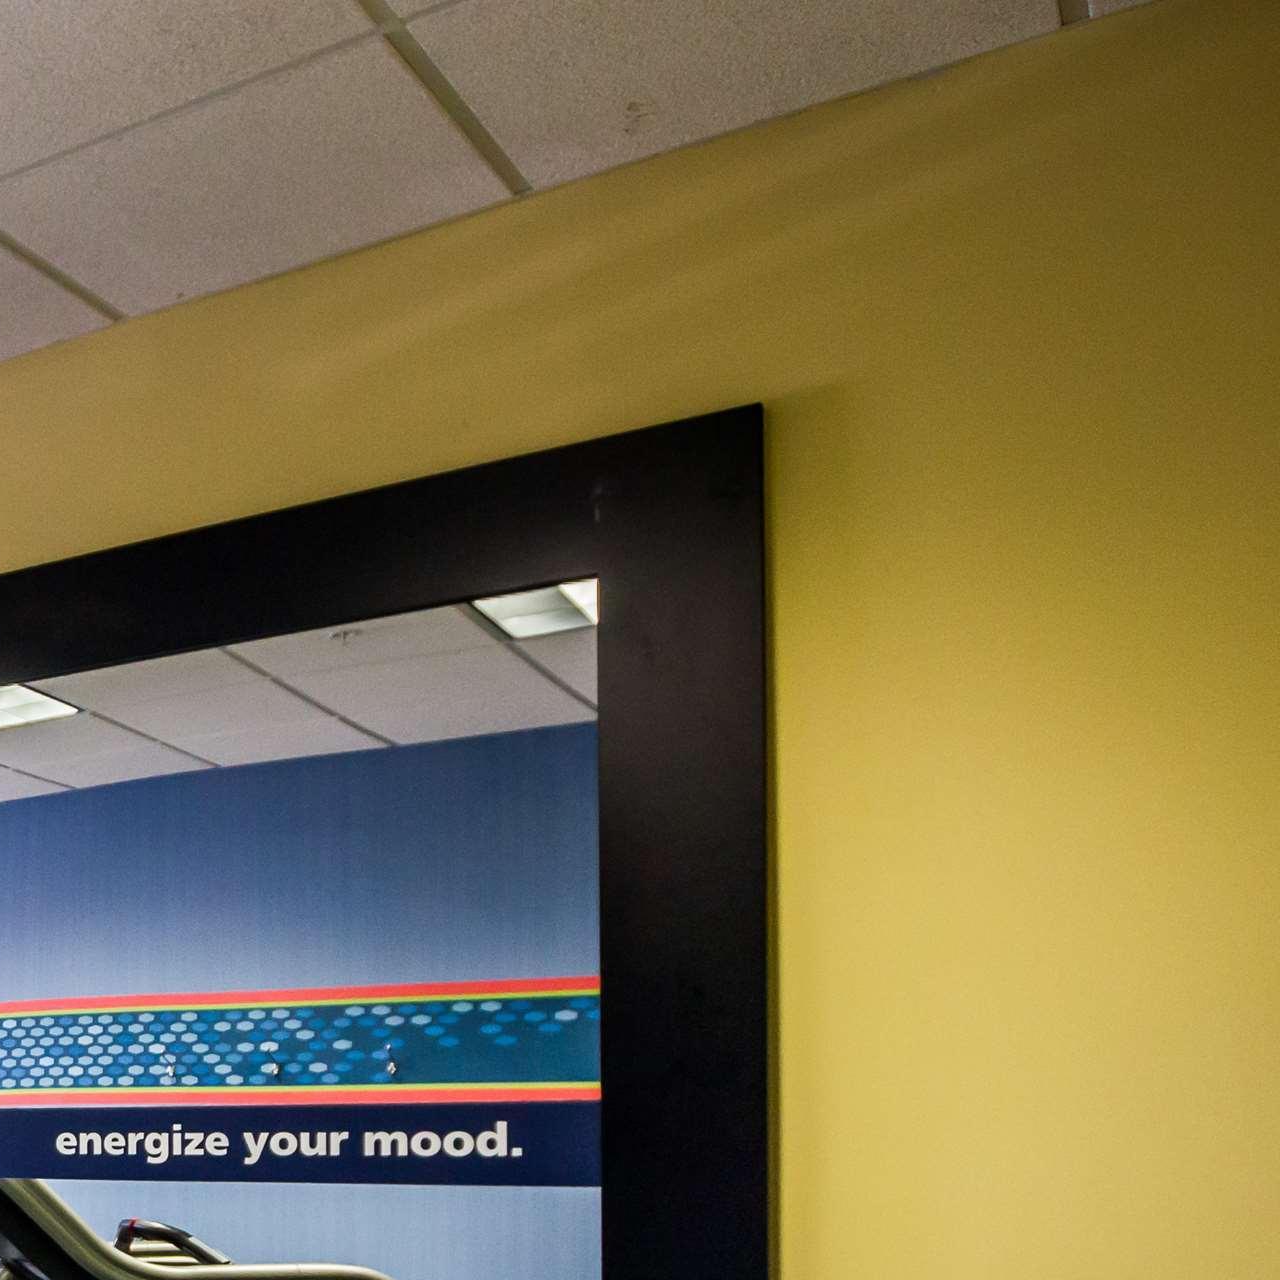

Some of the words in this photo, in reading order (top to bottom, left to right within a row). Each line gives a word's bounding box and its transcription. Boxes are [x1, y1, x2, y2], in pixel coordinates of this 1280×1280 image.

[55, 1123, 229, 1163] energize
[243, 1129, 349, 1165] your
[363, 1121, 523, 1157] mood.
